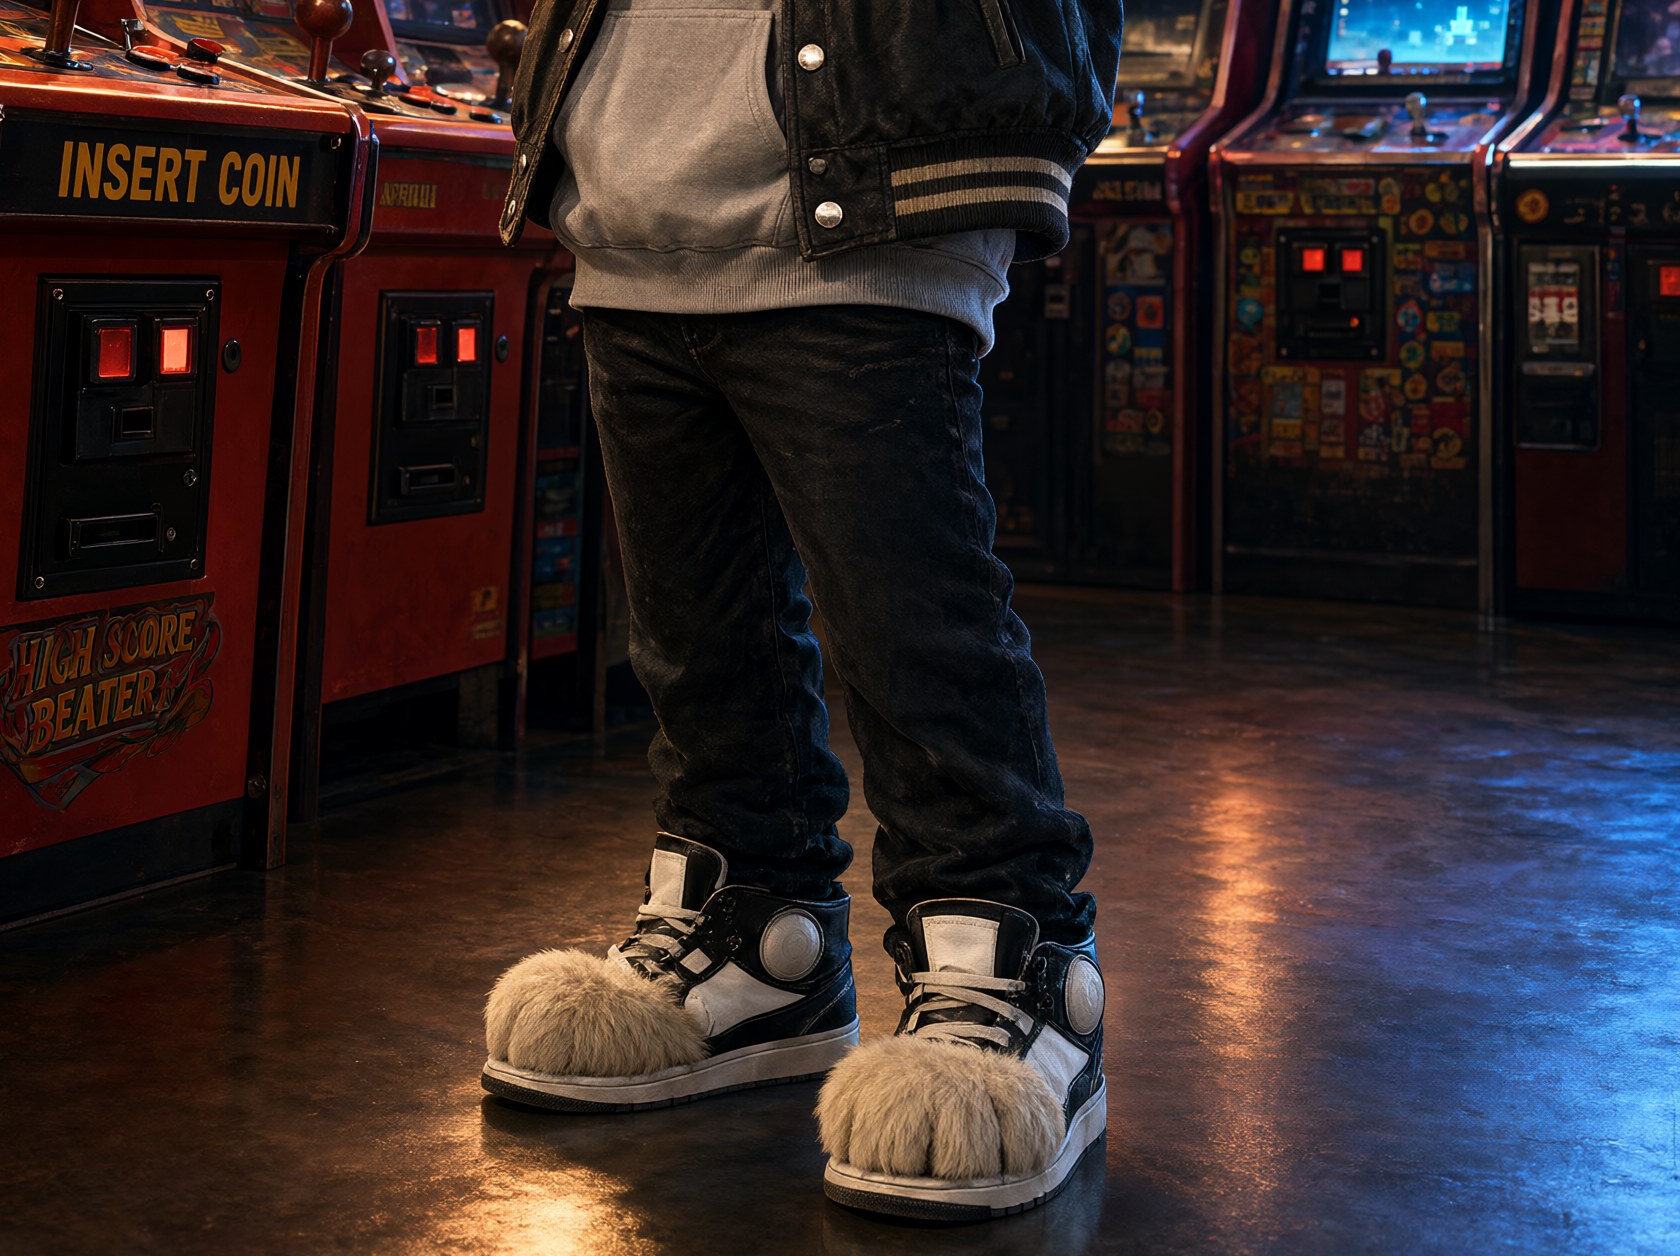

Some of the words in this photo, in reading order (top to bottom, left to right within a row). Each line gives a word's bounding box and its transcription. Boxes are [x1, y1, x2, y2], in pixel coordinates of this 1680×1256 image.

[58, 140, 208, 203] INSERT
[218, 151, 301, 208] COIN
[13, 625, 98, 700] HIGH
[103, 610, 197, 669] SCORE
[26, 668, 157, 756] BEATER
